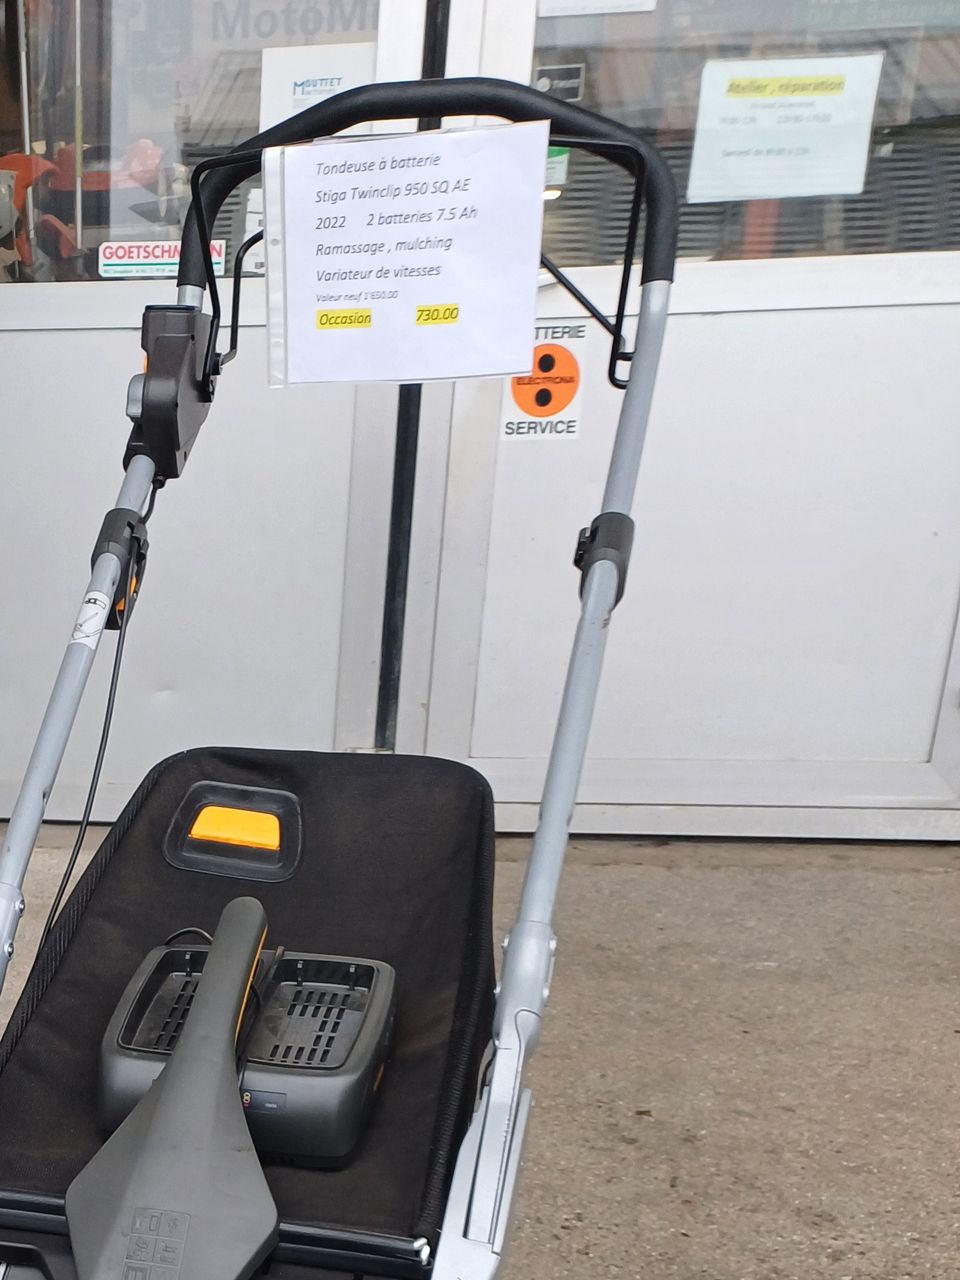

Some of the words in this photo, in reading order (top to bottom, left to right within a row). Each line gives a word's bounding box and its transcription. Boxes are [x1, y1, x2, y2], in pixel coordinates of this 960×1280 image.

[316, 160, 375, 176] Tondeuse
[378, 158, 387, 170] à
[390, 154, 441, 169] batterie
[315, 190, 347, 205] Stiga
[351, 184, 401, 201] Twinclip
[404, 182, 428, 196] 950
[430, 180, 449, 194] SQ
[451, 178, 471, 192] AE
[315, 216, 346, 230] 2022
[366, 214, 374, 226] 2
[377, 210, 432, 226] batteries
[436, 207, 456, 221] 7.5
[458, 206, 478, 220] Ah
[316, 242, 385, 256] Ramassage
[395, 236, 453, 253] mulching
[316, 267, 373, 282] Variateur
[375, 266, 390, 279] de
[393, 265, 442, 278] vitesses
[319, 311, 371, 326] Occasion
[416, 307, 459, 322] 730.00
[535, 325, 586, 340] TTERIE
[505, 420, 577, 435] SERVICE
